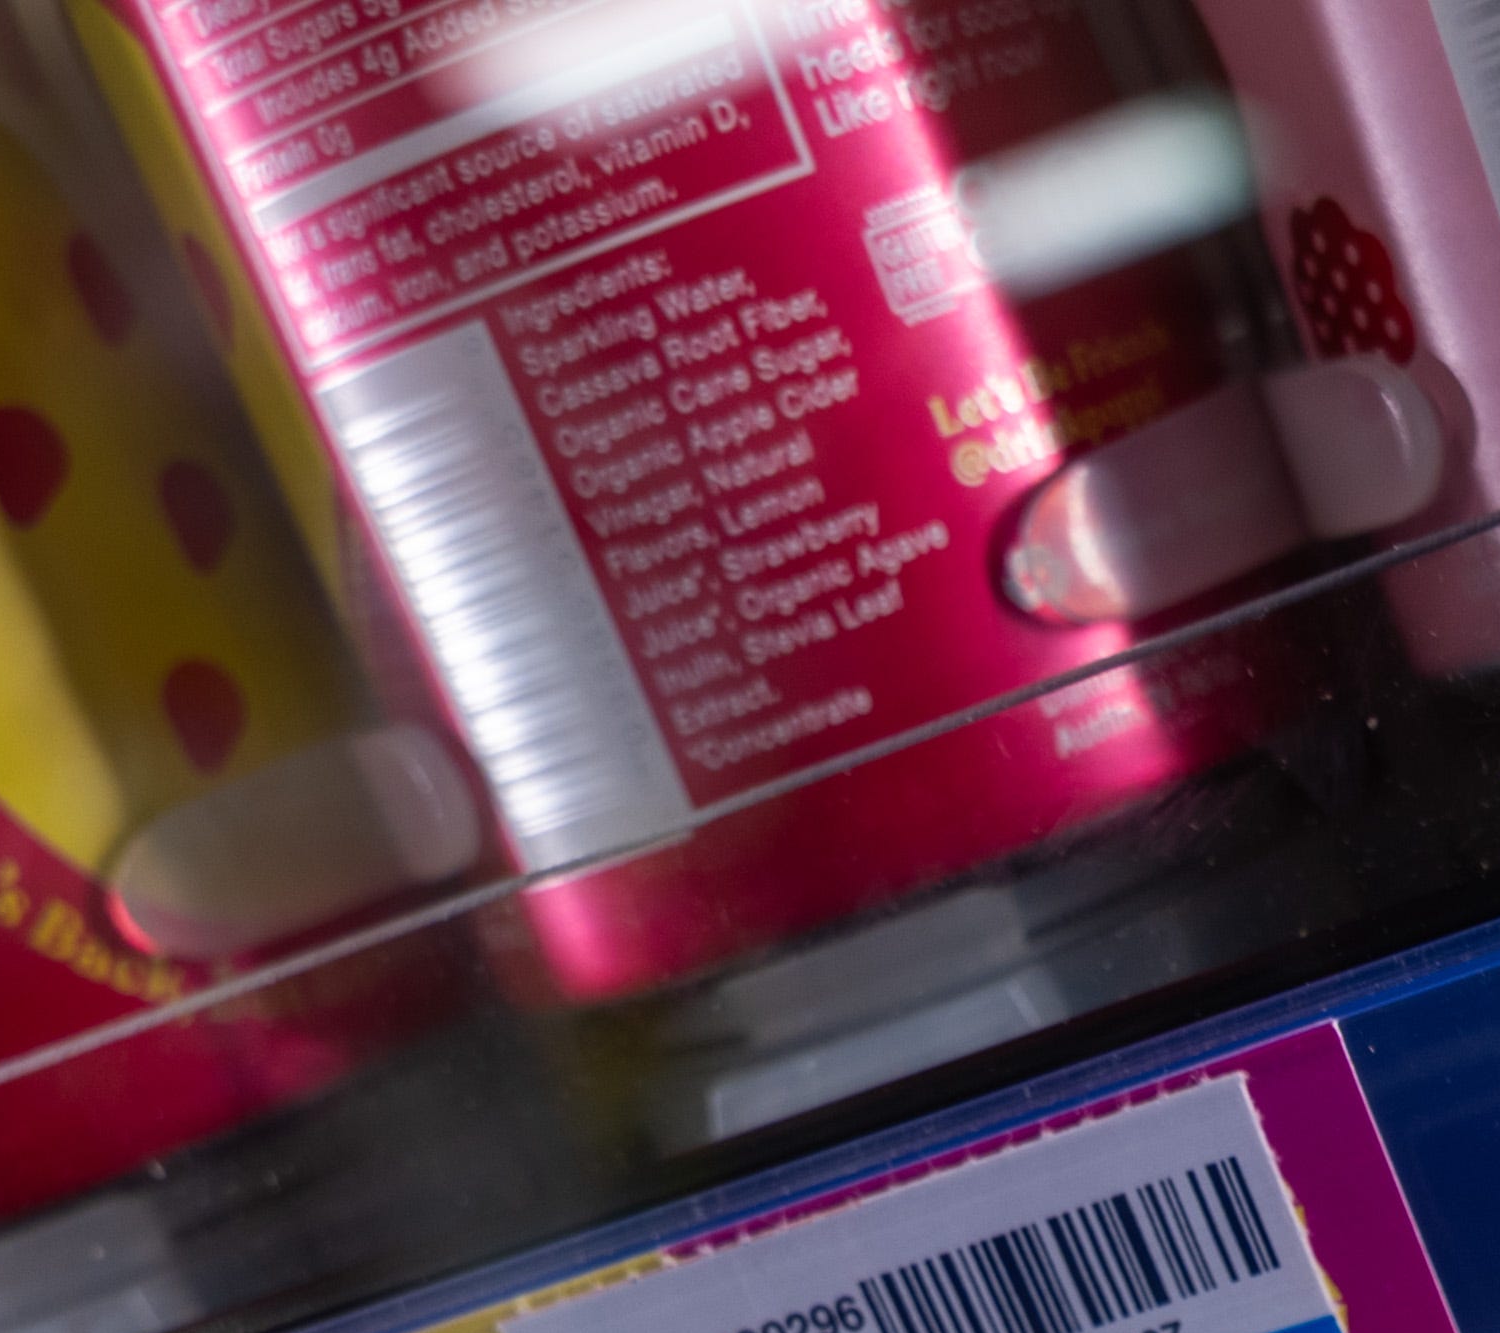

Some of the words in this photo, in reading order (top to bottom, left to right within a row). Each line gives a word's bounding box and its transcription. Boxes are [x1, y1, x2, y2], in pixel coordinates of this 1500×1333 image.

[424, 155, 595, 246] cholesterol,
[595, 114, 706, 178] vitamin
[707, 97, 752, 133] D,
[456, 123, 557, 186] source
[510, 175, 679, 262] potassium.
[500, 247, 673, 339] Ingredients:
[518, 302, 658, 378] Sparkling
[653, 265, 758, 323] Water,
[534, 350, 663, 419] Cassava
[736, 287, 829, 341] Fiber,
[748, 324, 853, 383] Sugar,
